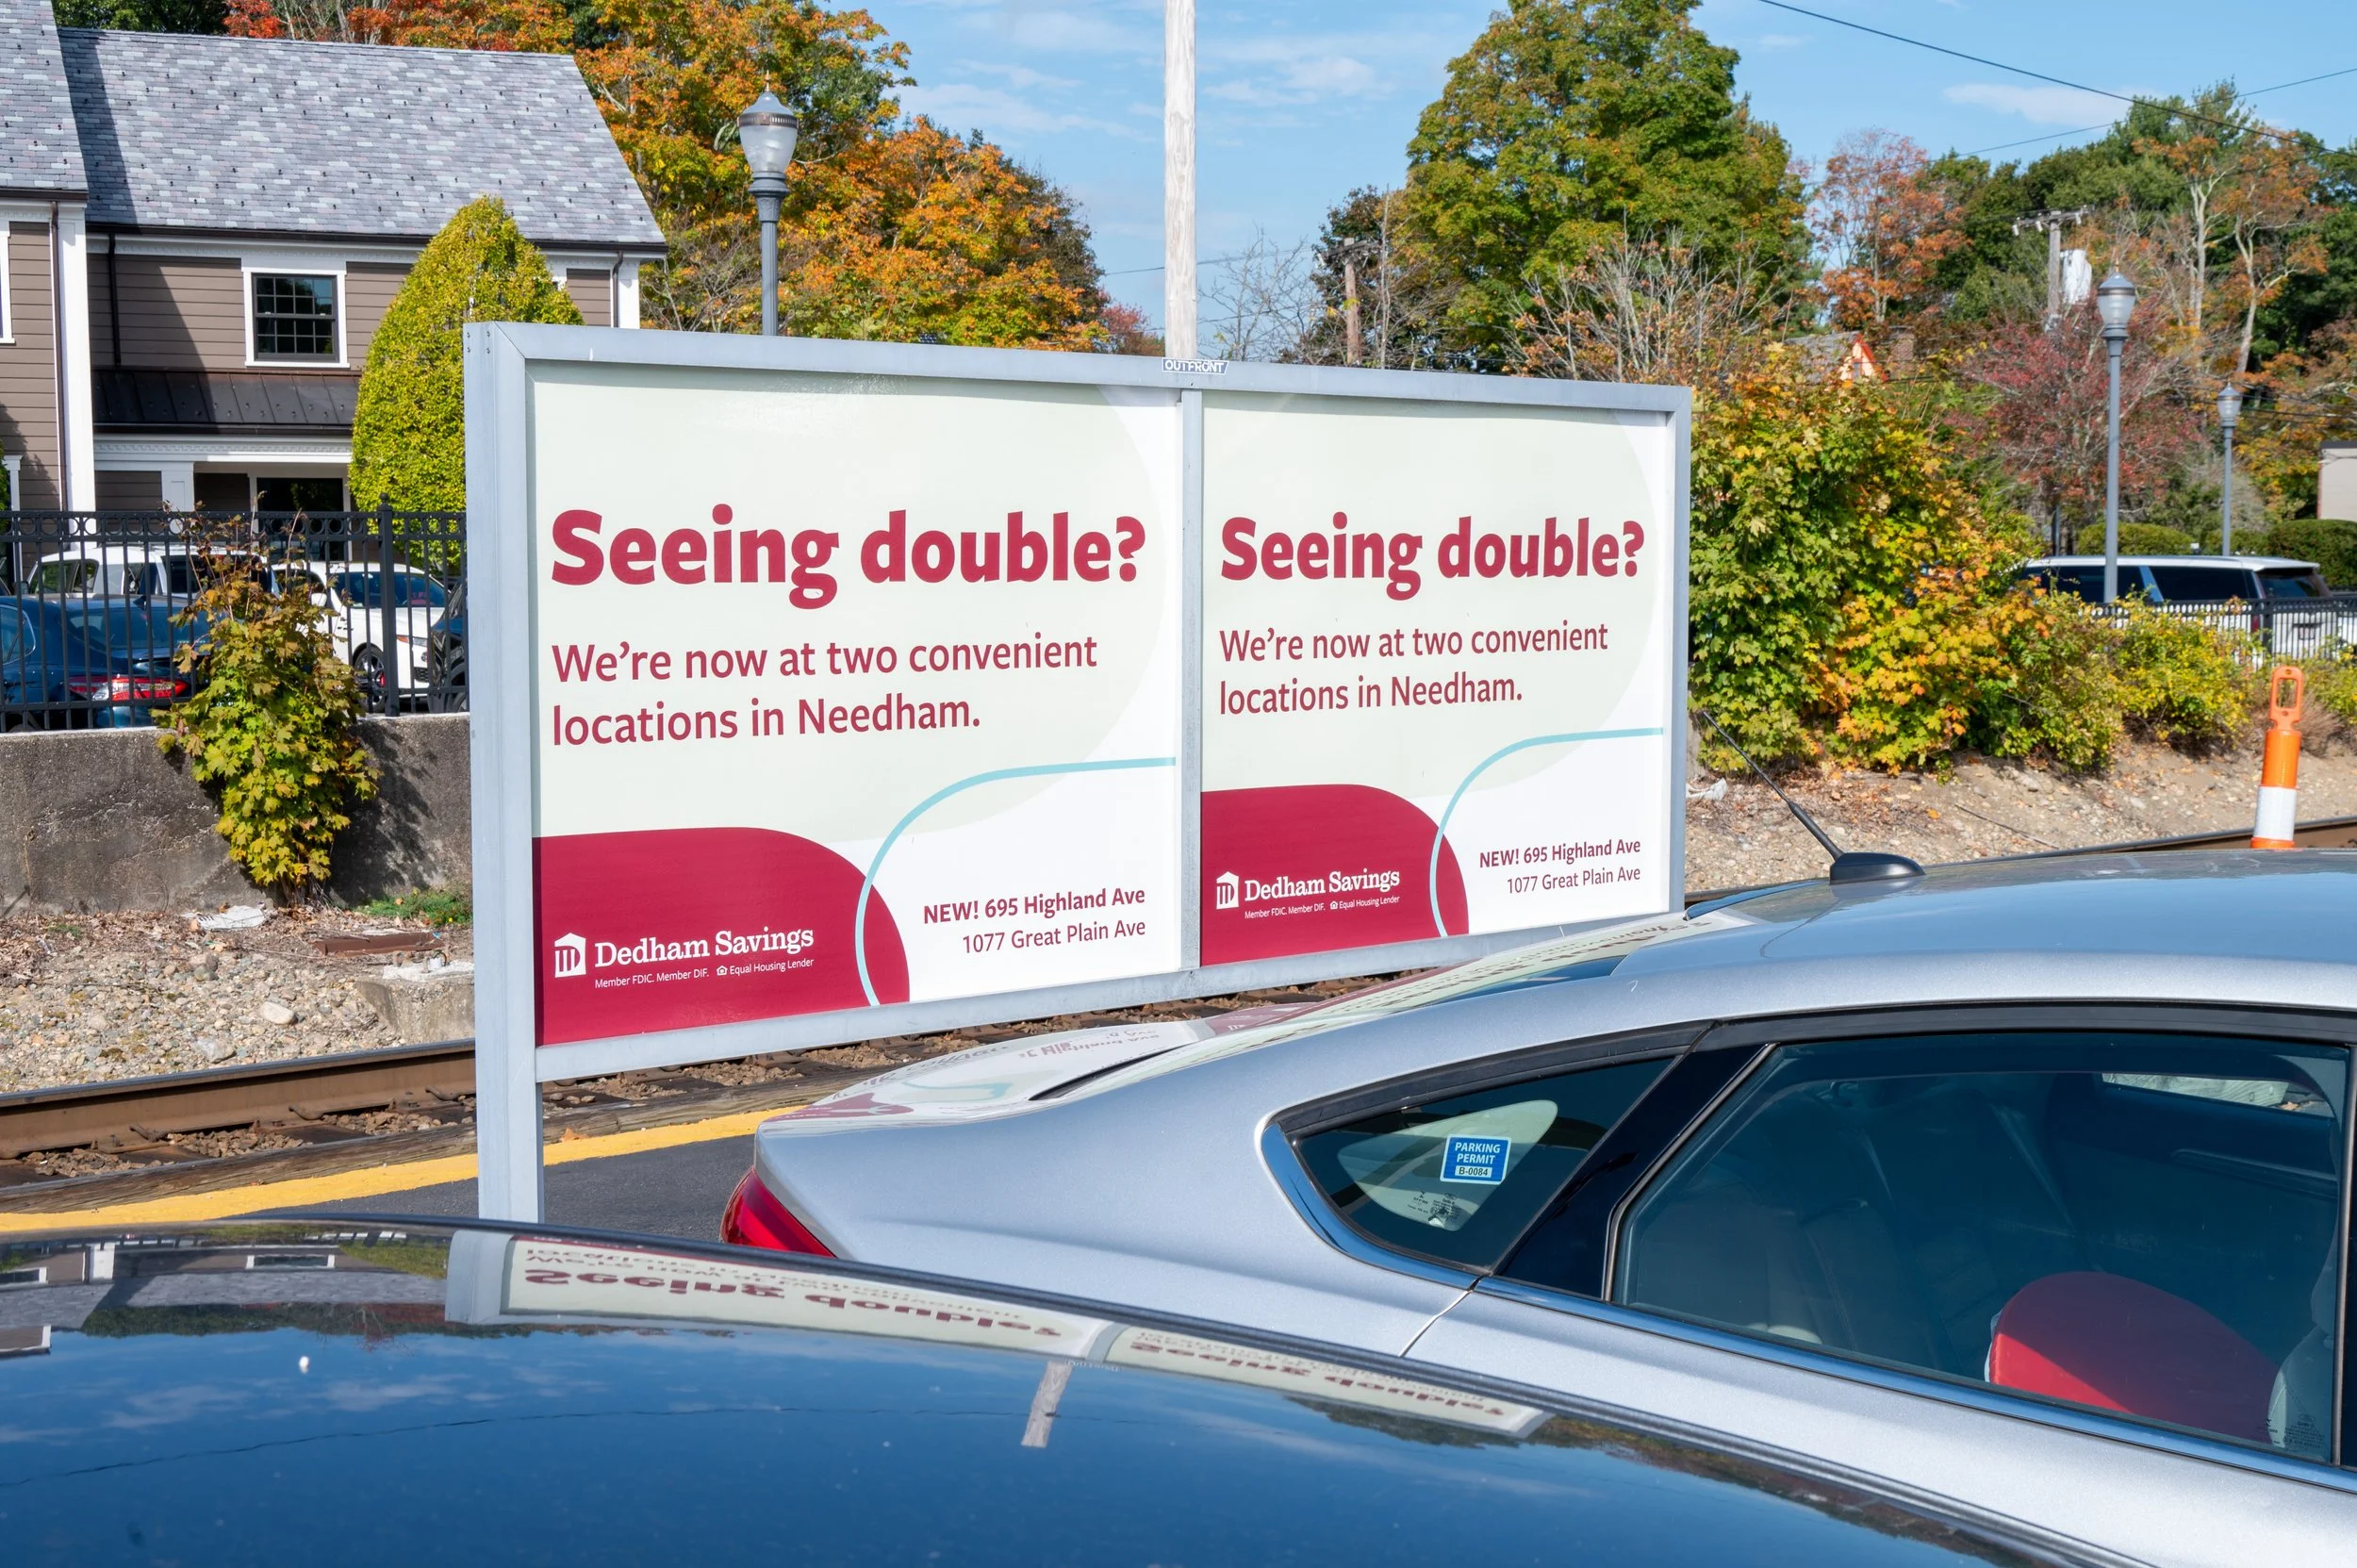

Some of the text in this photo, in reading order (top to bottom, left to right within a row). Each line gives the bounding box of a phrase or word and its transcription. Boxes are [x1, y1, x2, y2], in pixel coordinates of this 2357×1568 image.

[1164, 359, 1225, 373] OUTFRONT
[552, 503, 1146, 609] Seeing double?
[1222, 512, 1644, 601] Seeing double?
[1220, 620, 1607, 661] We're now at two convenient
[552, 633, 1096, 682] We're now at two convenient
[1221, 673, 1522, 714] locations in Needham.
[554, 694, 979, 745] locations in Needham.
[1480, 839, 1640, 867] NEW! 695 Highland Ave
[1244, 868, 1400, 901] Dedham Savings
[1508, 867, 1640, 893] 1077 Great Plain Ave
[924, 888, 1145, 924] NEW! 695 Highland Ave
[1244, 895, 1400, 919] Member FDIC. Member DIF. Equal Housing Lender
[595, 927, 814, 967] Dedham Savings
[964, 920, 1145, 953] 1077 Great Plain Ave
[595, 957, 815, 988] Member FDIC. Member DIF. Equal Housing Lender
[1455, 1142, 1501, 1153] PARKING
[1457, 1153, 1495, 1164] PERMIT
[1459, 1166, 1489, 1176] B-0084
